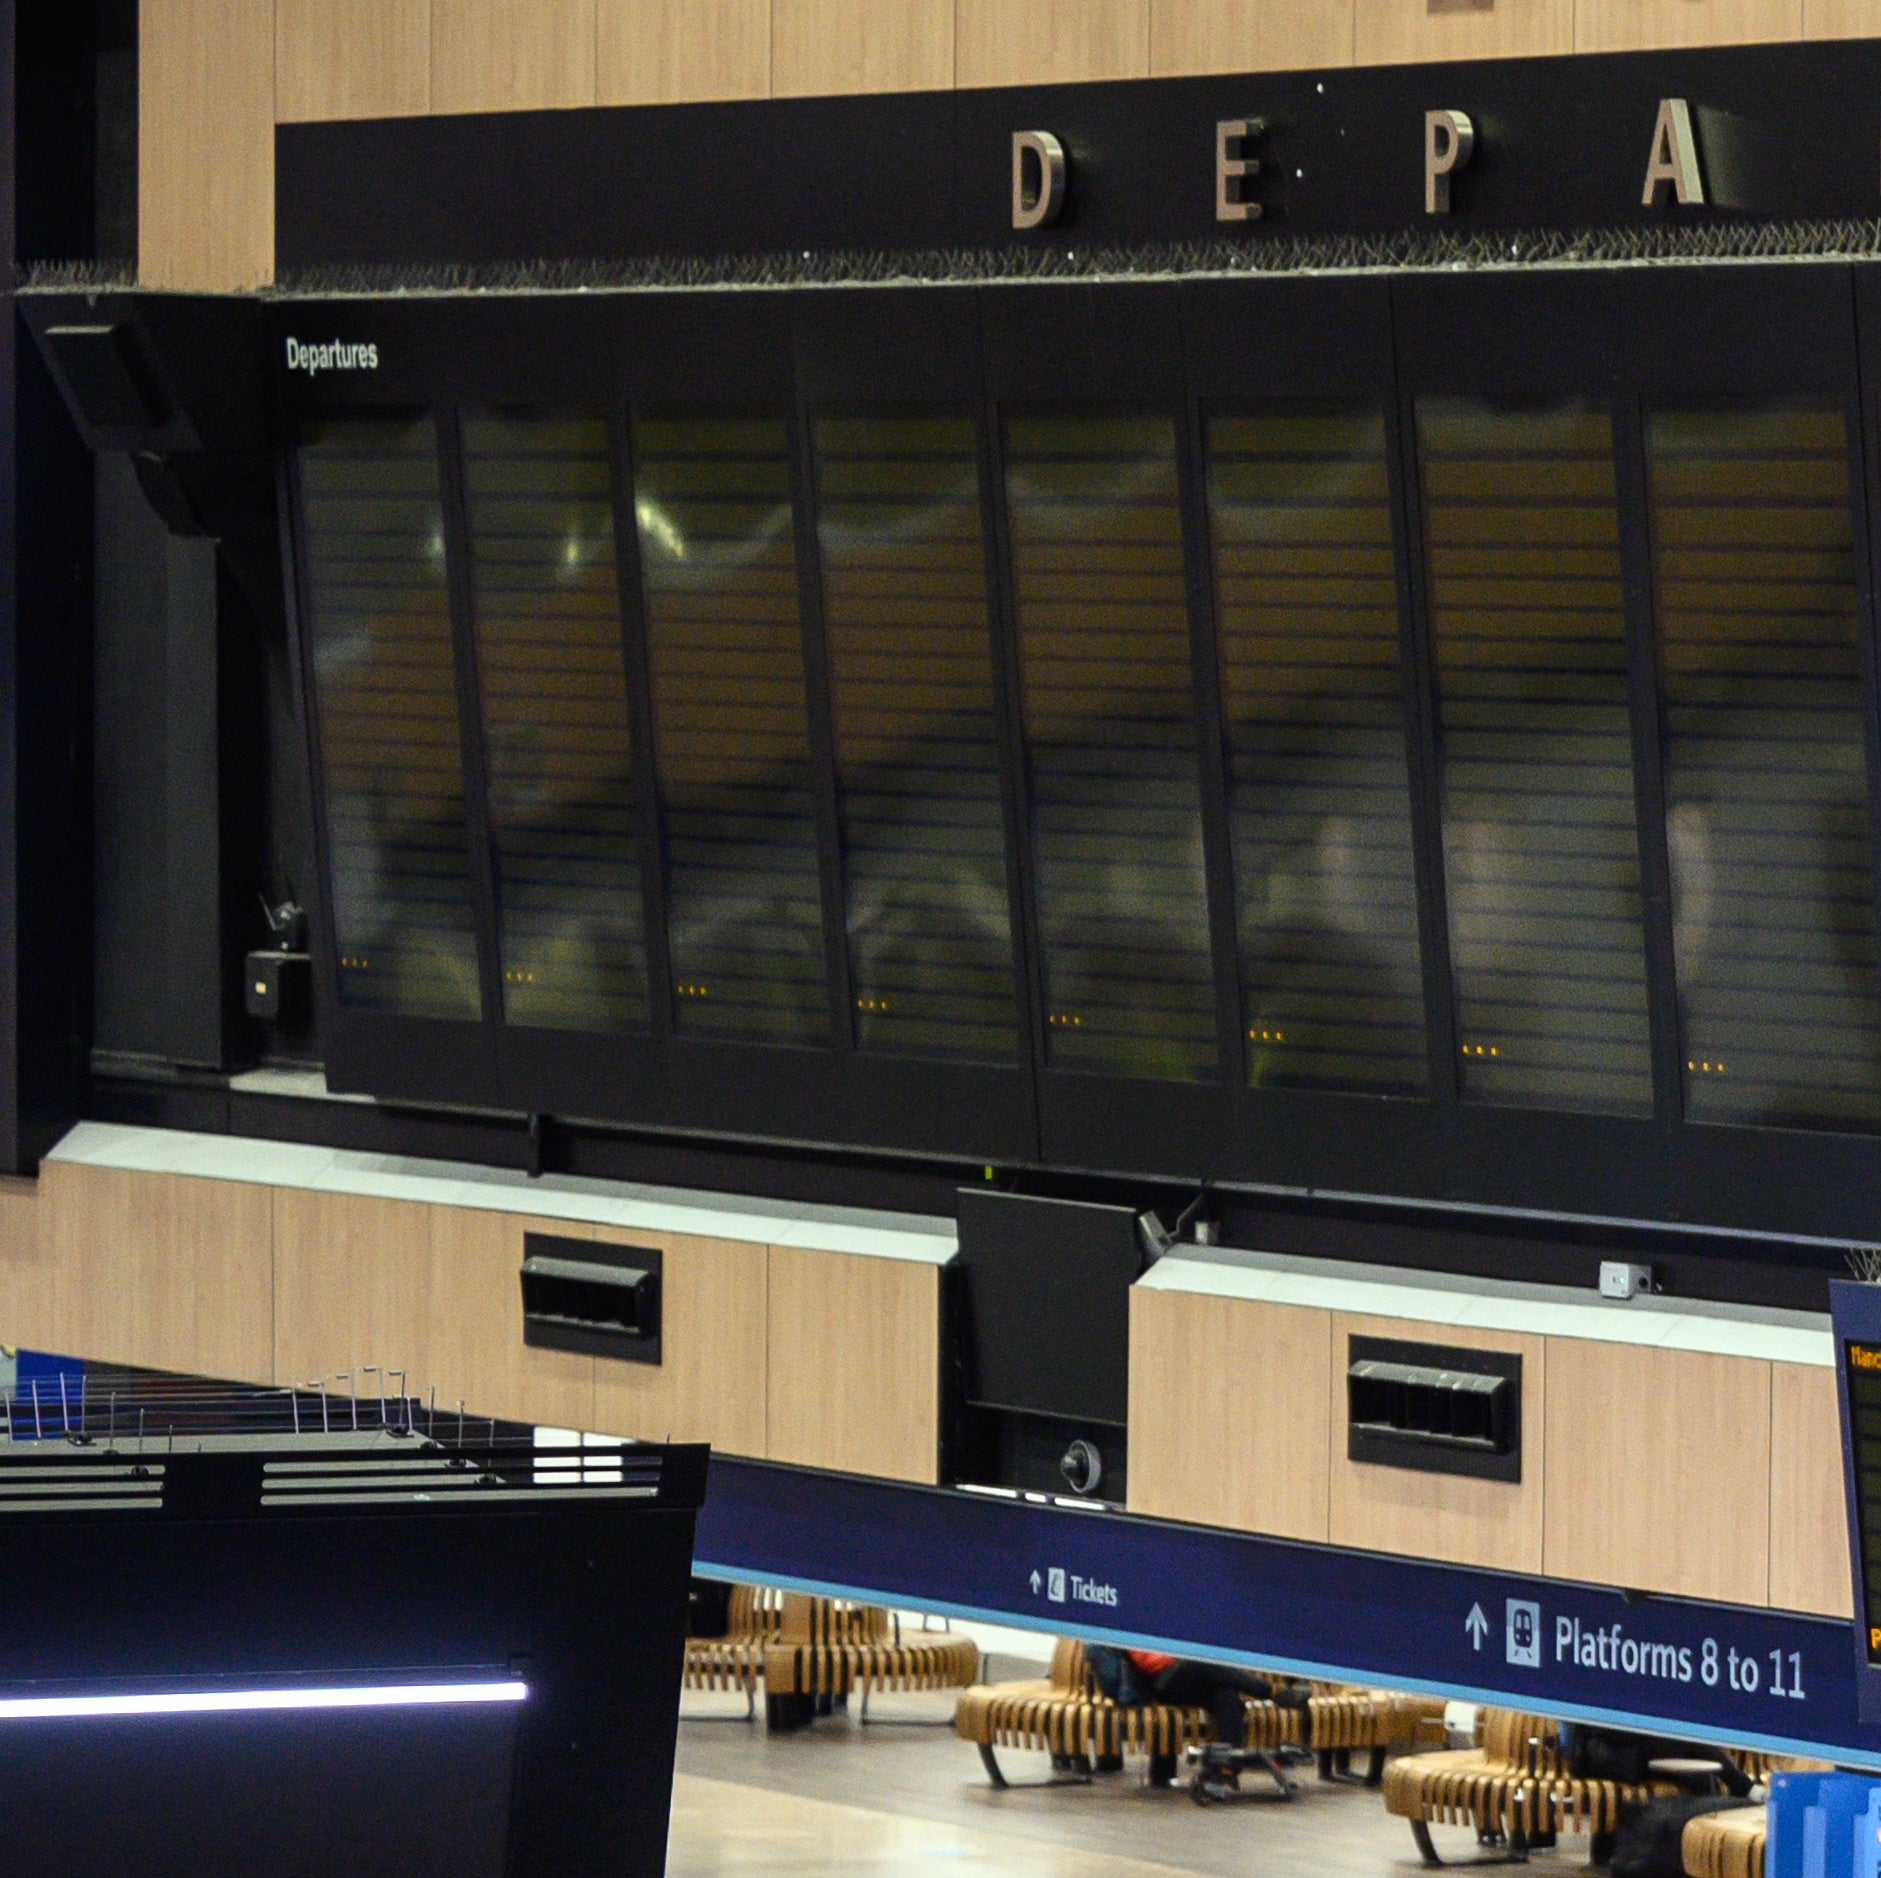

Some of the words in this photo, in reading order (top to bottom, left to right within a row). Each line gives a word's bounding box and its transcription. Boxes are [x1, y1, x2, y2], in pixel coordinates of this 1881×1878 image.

[286, 337, 378, 376] Departures
[1070, 1575, 1118, 1607] Tickets
[1554, 1615, 1693, 1684] Platforms
[1700, 1637, 1721, 1687] 8
[1728, 1645, 1759, 1694] to
[1769, 1649, 1807, 1699] 11
